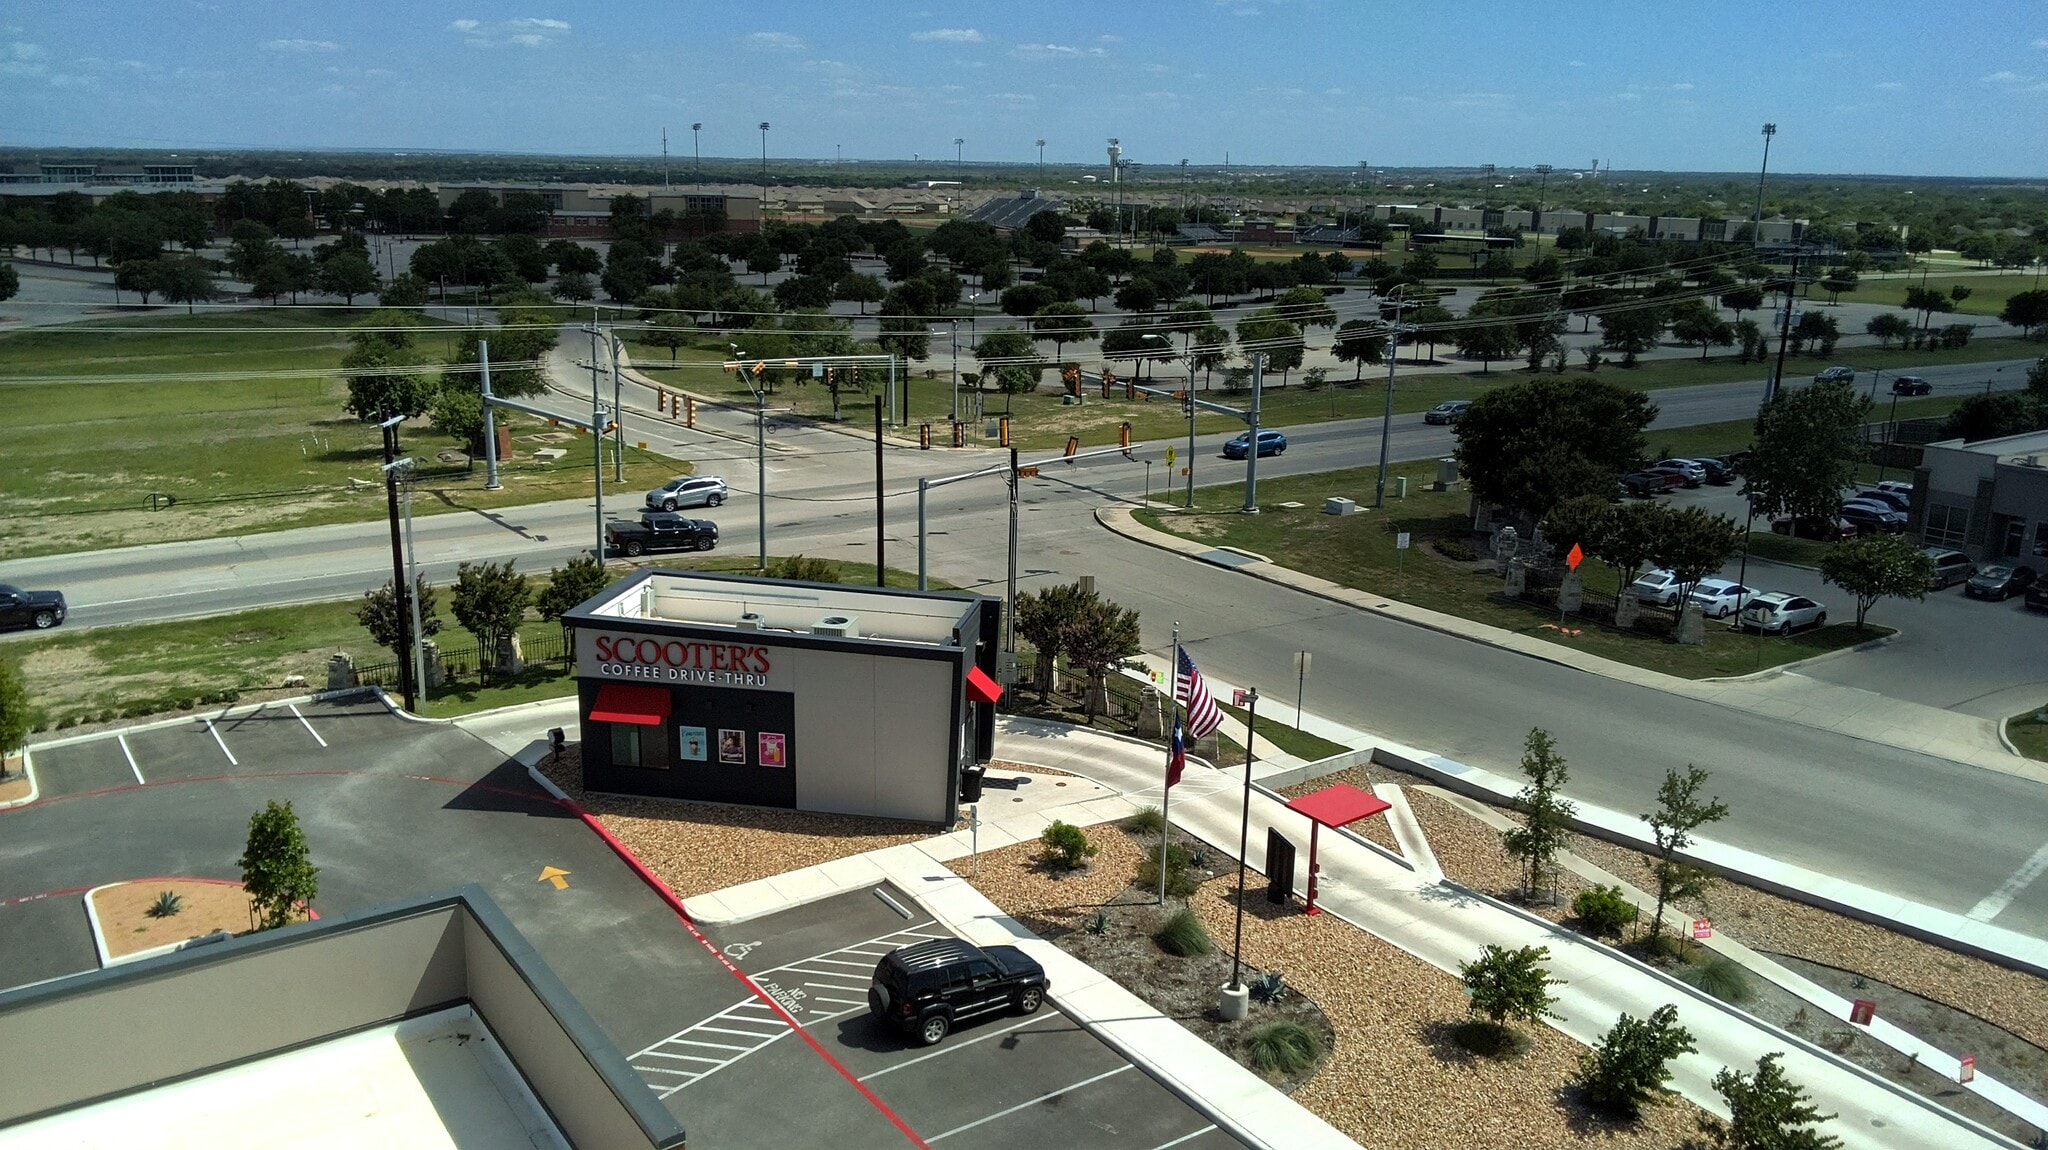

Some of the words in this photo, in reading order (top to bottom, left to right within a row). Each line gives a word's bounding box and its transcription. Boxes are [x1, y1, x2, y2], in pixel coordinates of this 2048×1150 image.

[595, 636, 770, 674] SCOOTER'S
[601, 663, 660, 679] COFFEE
[669, 668, 767, 687] DRIVE-THRU
[764, 982, 804, 1013] PARKING
[787, 988, 807, 1000] NO
